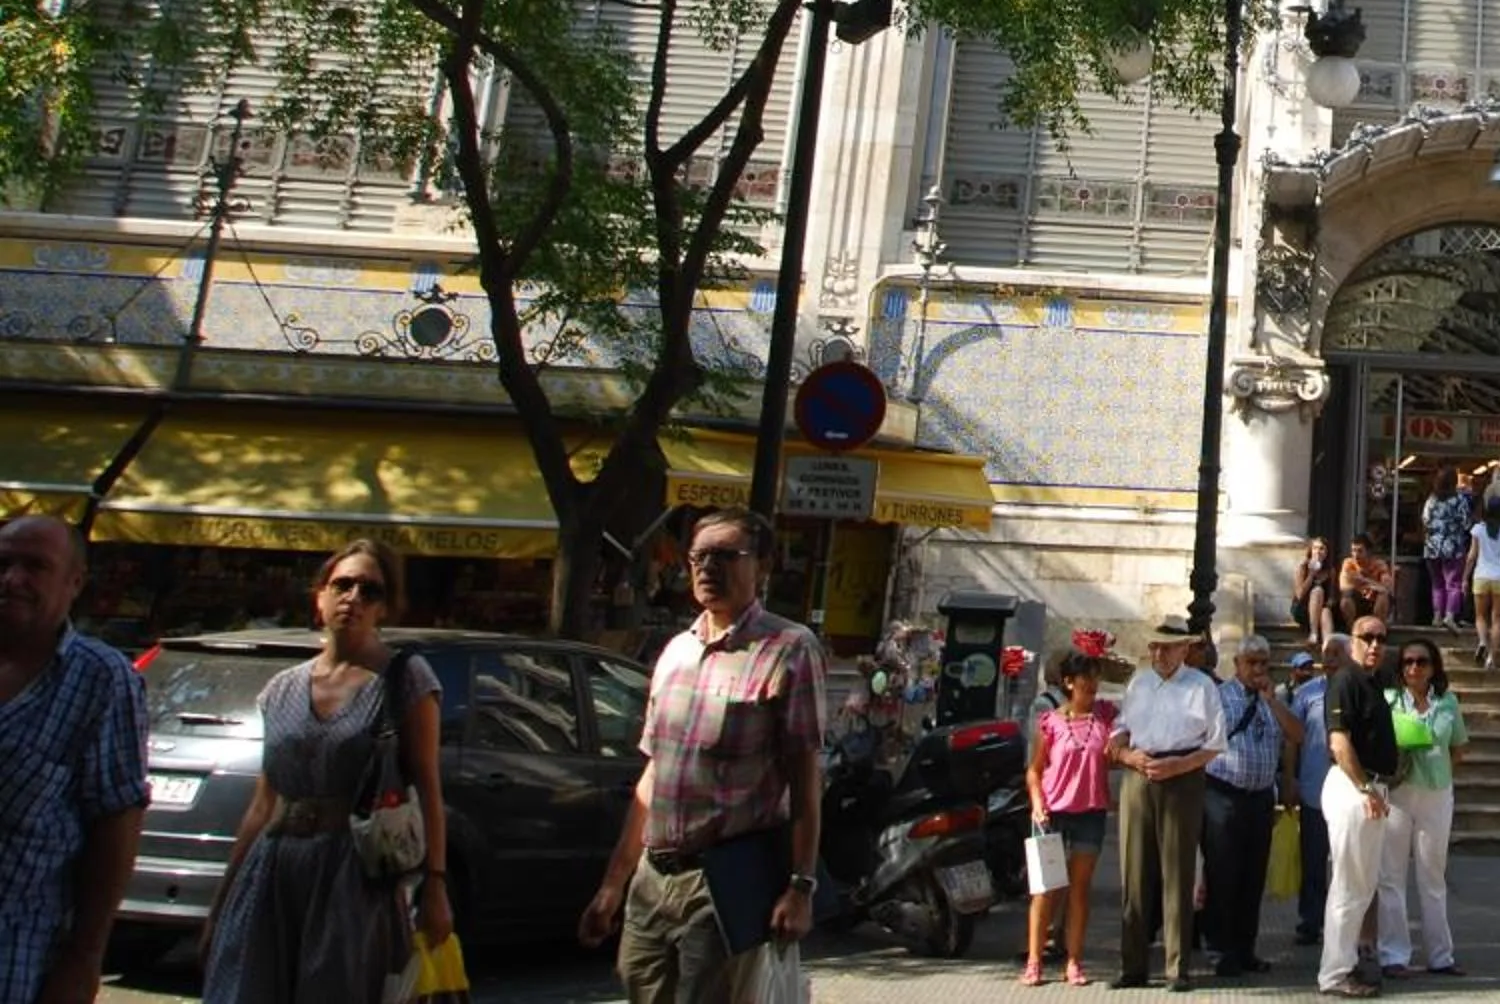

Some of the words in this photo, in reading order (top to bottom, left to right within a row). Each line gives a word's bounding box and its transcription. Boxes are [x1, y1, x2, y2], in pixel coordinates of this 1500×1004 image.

[880, 503, 890, 519] Y
[892, 503, 964, 525] TURRONES
[181, 518, 317, 546] TURRONES
